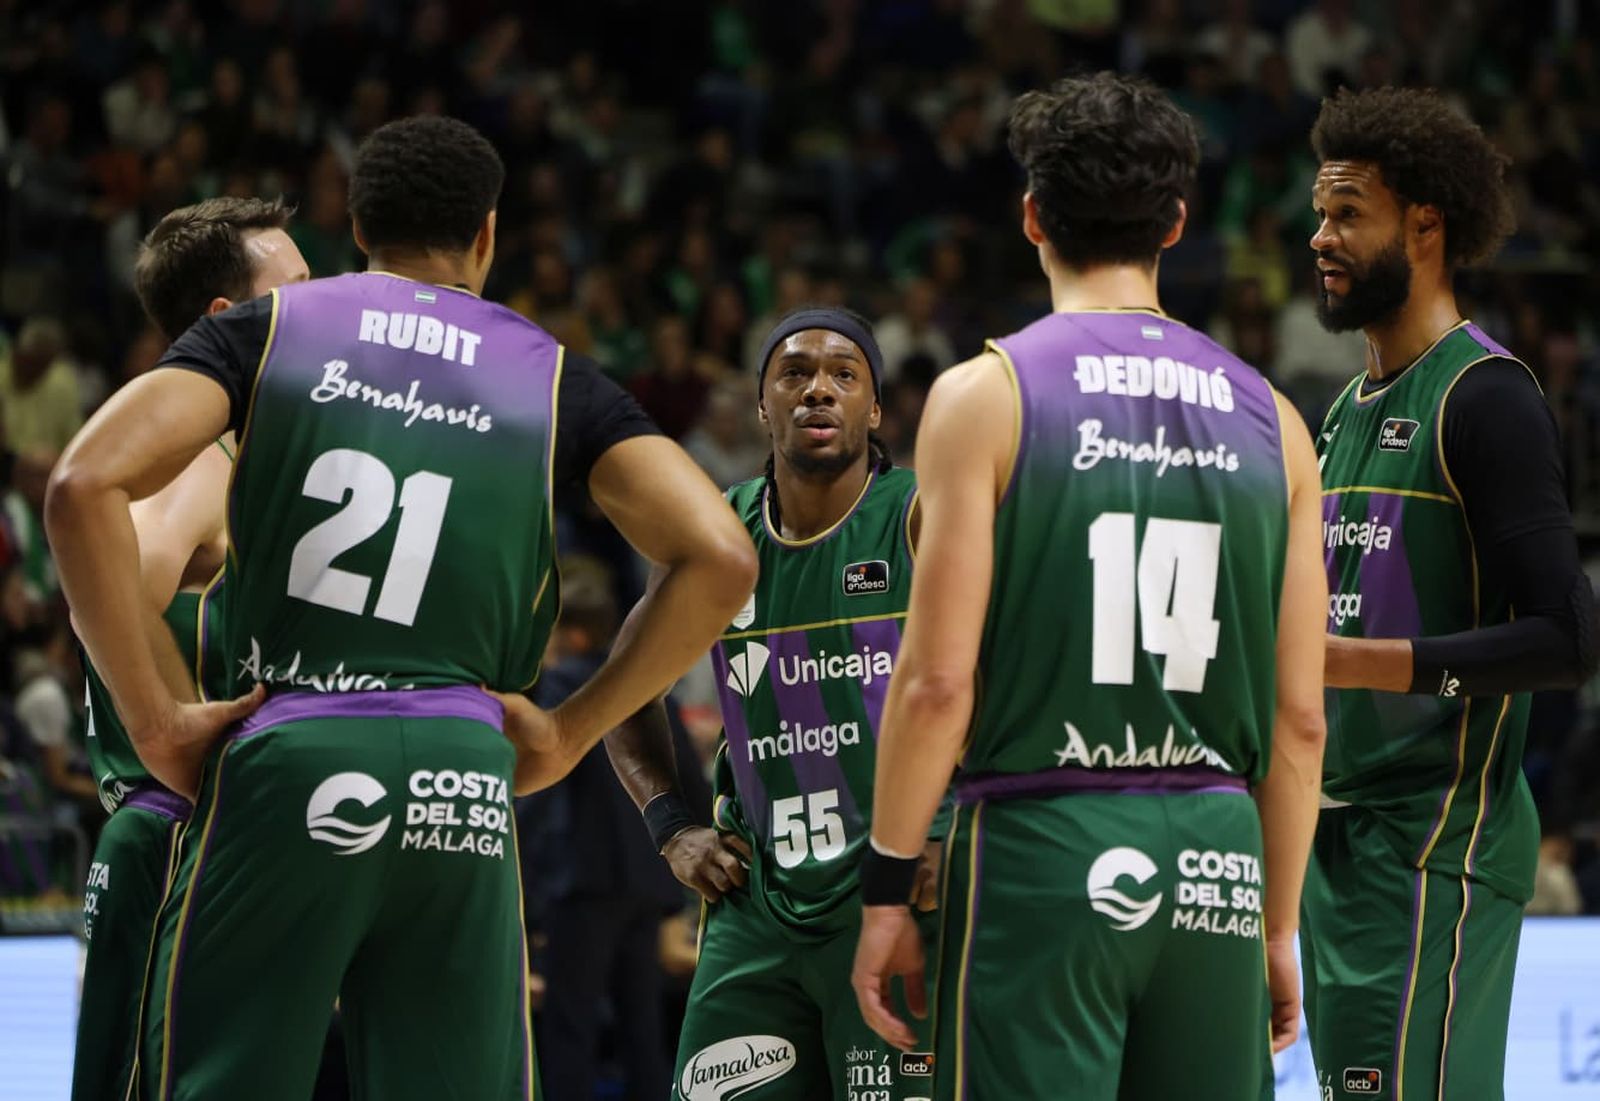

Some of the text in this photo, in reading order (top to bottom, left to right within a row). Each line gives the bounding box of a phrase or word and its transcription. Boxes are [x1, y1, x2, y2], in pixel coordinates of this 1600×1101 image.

[358, 309, 482, 366] RUBIT
[1073, 355, 1235, 413] ĐEDOVIĆ
[287, 448, 453, 627] 21
[1088, 512, 1222, 694] 14
[778, 645, 893, 686] Unicaja
[408, 769, 509, 807] COSTA
[406, 803, 509, 833] DEL SOL
[772, 789, 846, 869] 55
[401, 826, 504, 859] MÁLAGA
[1177, 850, 1262, 886] COSTA
[1175, 882, 1228, 908] DEL
[1171, 908, 1260, 939] MÁLAGA
[846, 1046, 877, 1062] sbor
[903, 1062, 929, 1073] acb
[1347, 1078, 1372, 1090] acb
